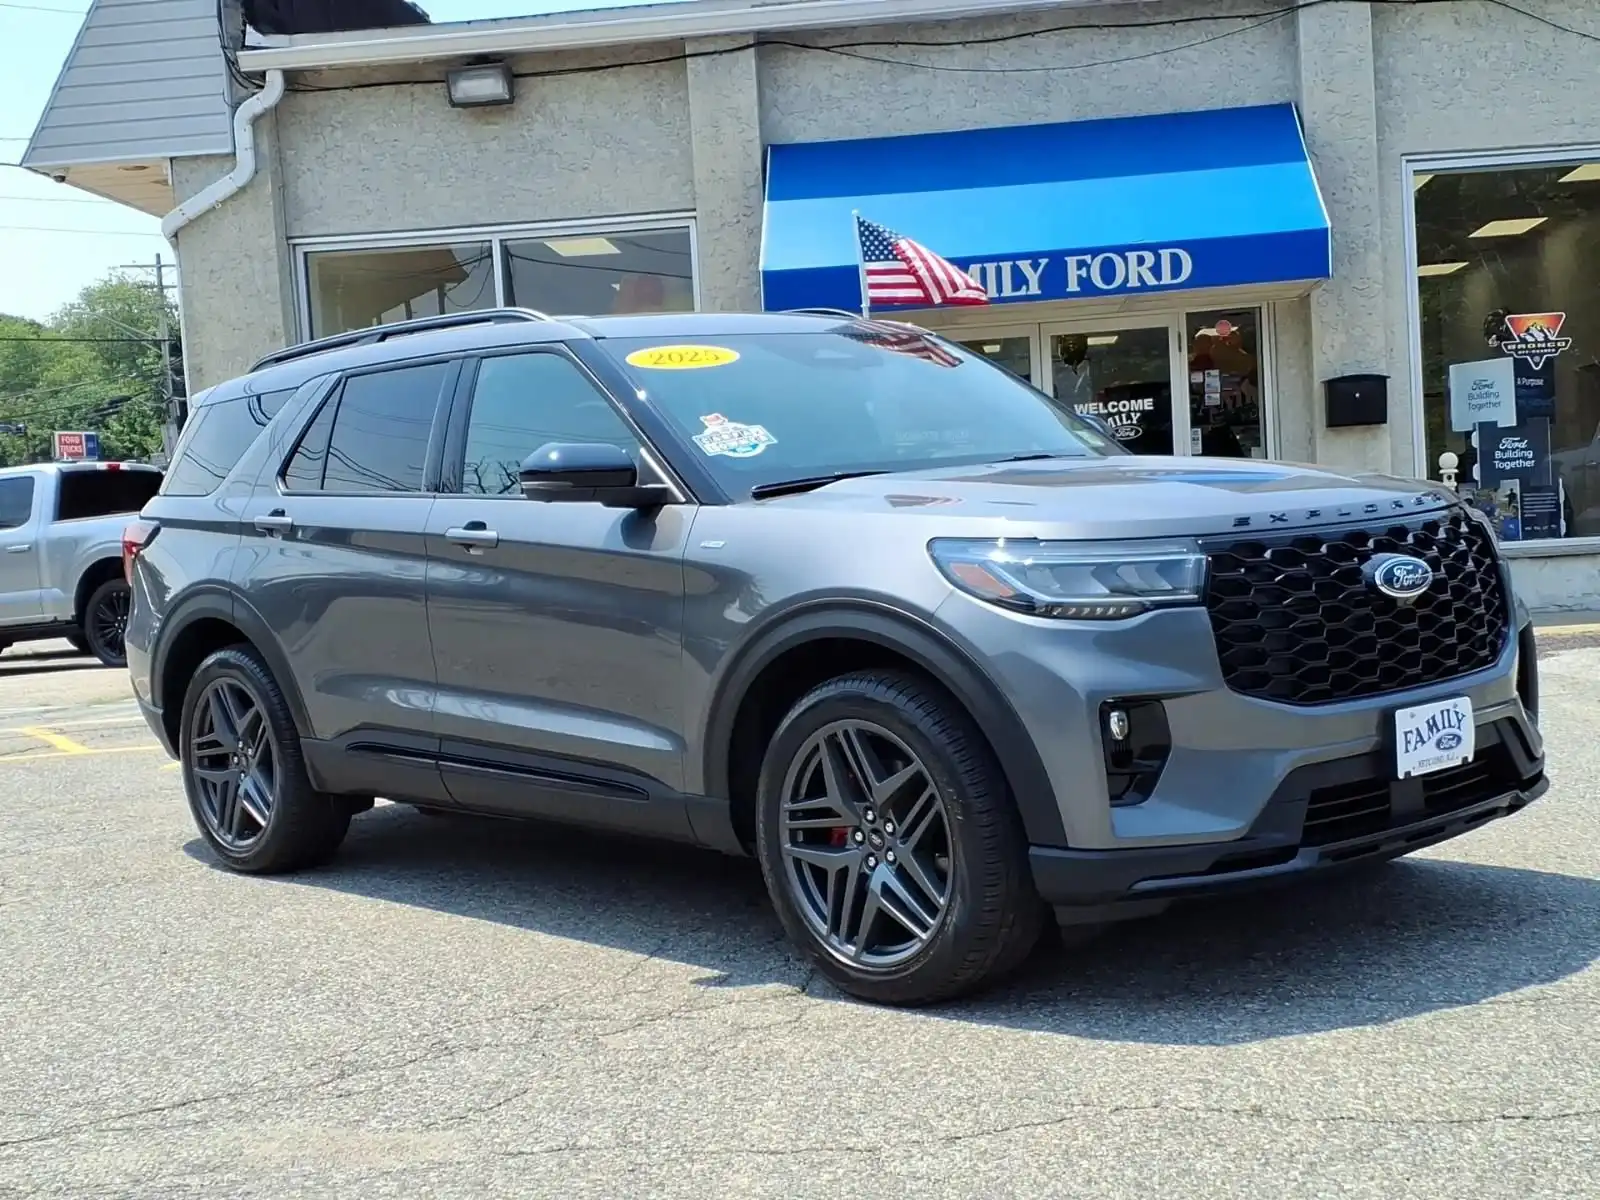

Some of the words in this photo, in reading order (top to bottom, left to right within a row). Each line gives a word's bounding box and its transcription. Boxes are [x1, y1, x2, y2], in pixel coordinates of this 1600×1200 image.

[1065, 248, 1192, 292] FORD
[1507, 341, 1566, 350] BRONCO
[650, 350, 720, 365] 2025
[1471, 379, 1495, 391] Ford
[1468, 391, 1499, 401] Building
[1074, 398, 1154, 415] WELCOME
[1468, 400, 1501, 411] Together
[1116, 427, 1136, 437] Ford
[61, 435, 80, 444] FORD
[1499, 437, 1528, 449] Ford
[1494, 449, 1533, 460] Building
[1493, 459, 1536, 470] Together
[1393, 565, 1427, 588] Ford
[1403, 708, 1467, 754] FAMILY
[1440, 735, 1458, 749] Ford
